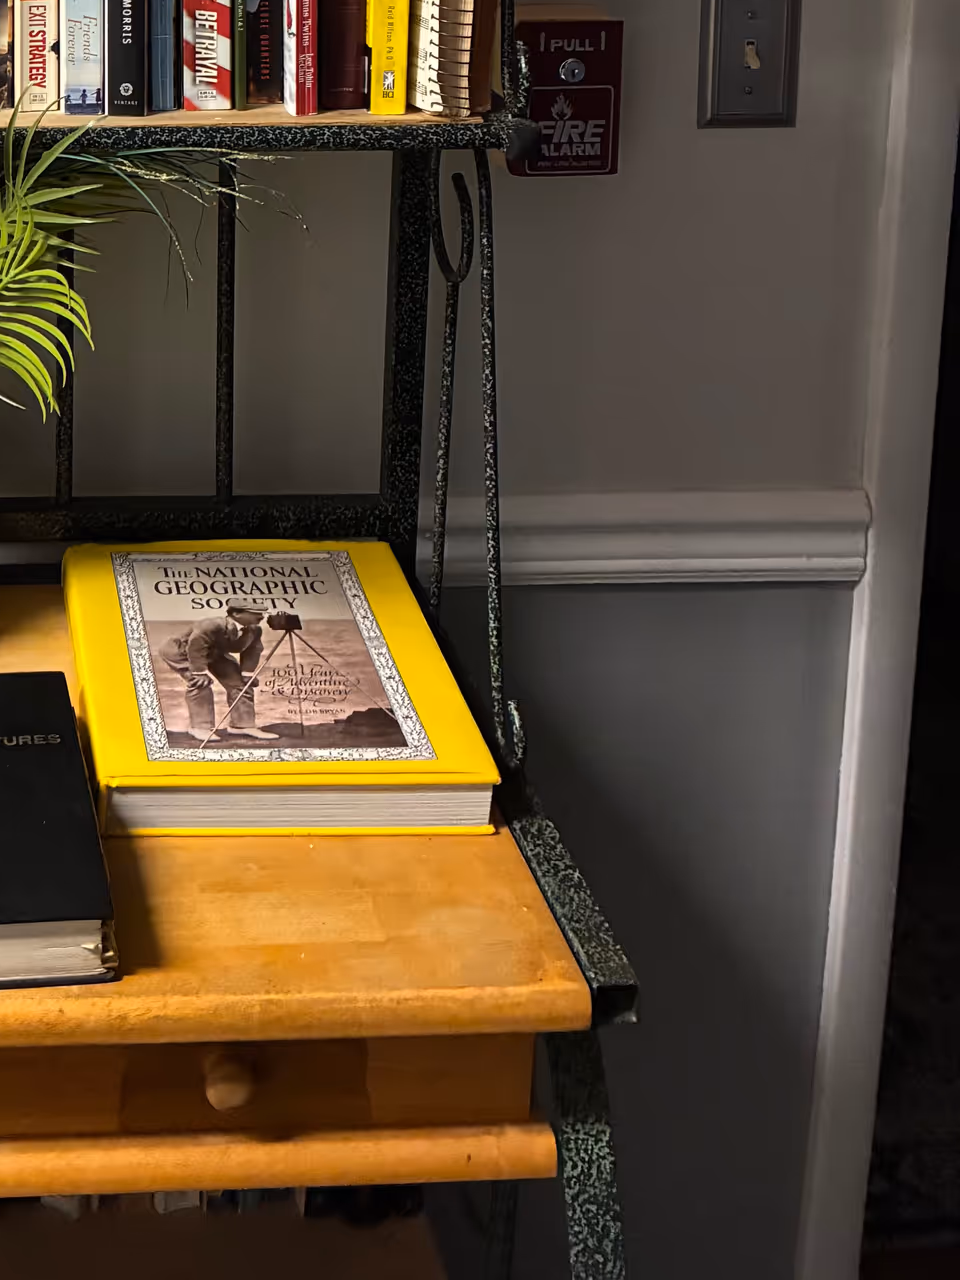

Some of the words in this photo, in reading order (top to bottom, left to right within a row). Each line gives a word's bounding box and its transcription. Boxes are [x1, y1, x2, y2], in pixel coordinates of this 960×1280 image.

[28, 5, 47, 28] EXIT
[260, 1, 269, 28] CLOSE
[194, 9, 219, 86] BETRAYAL
[550, 39, 594, 52] PULL
[28, 30, 47, 89] STRATEGY
[260, 33, 270, 80] QUARTERS
[538, 120, 606, 143] FIRE
[541, 143, 601, 157] ALARM
[158, 566, 193, 578] THE
[195, 566, 319, 579] NATIONAL
[154, 580, 328, 595] GEOGRAPHIC
[271, 667, 298, 678] 100
[265, 677, 278, 690] of
[280, 678, 356, 688] Adventure
[289, 687, 351, 701] Discovery
